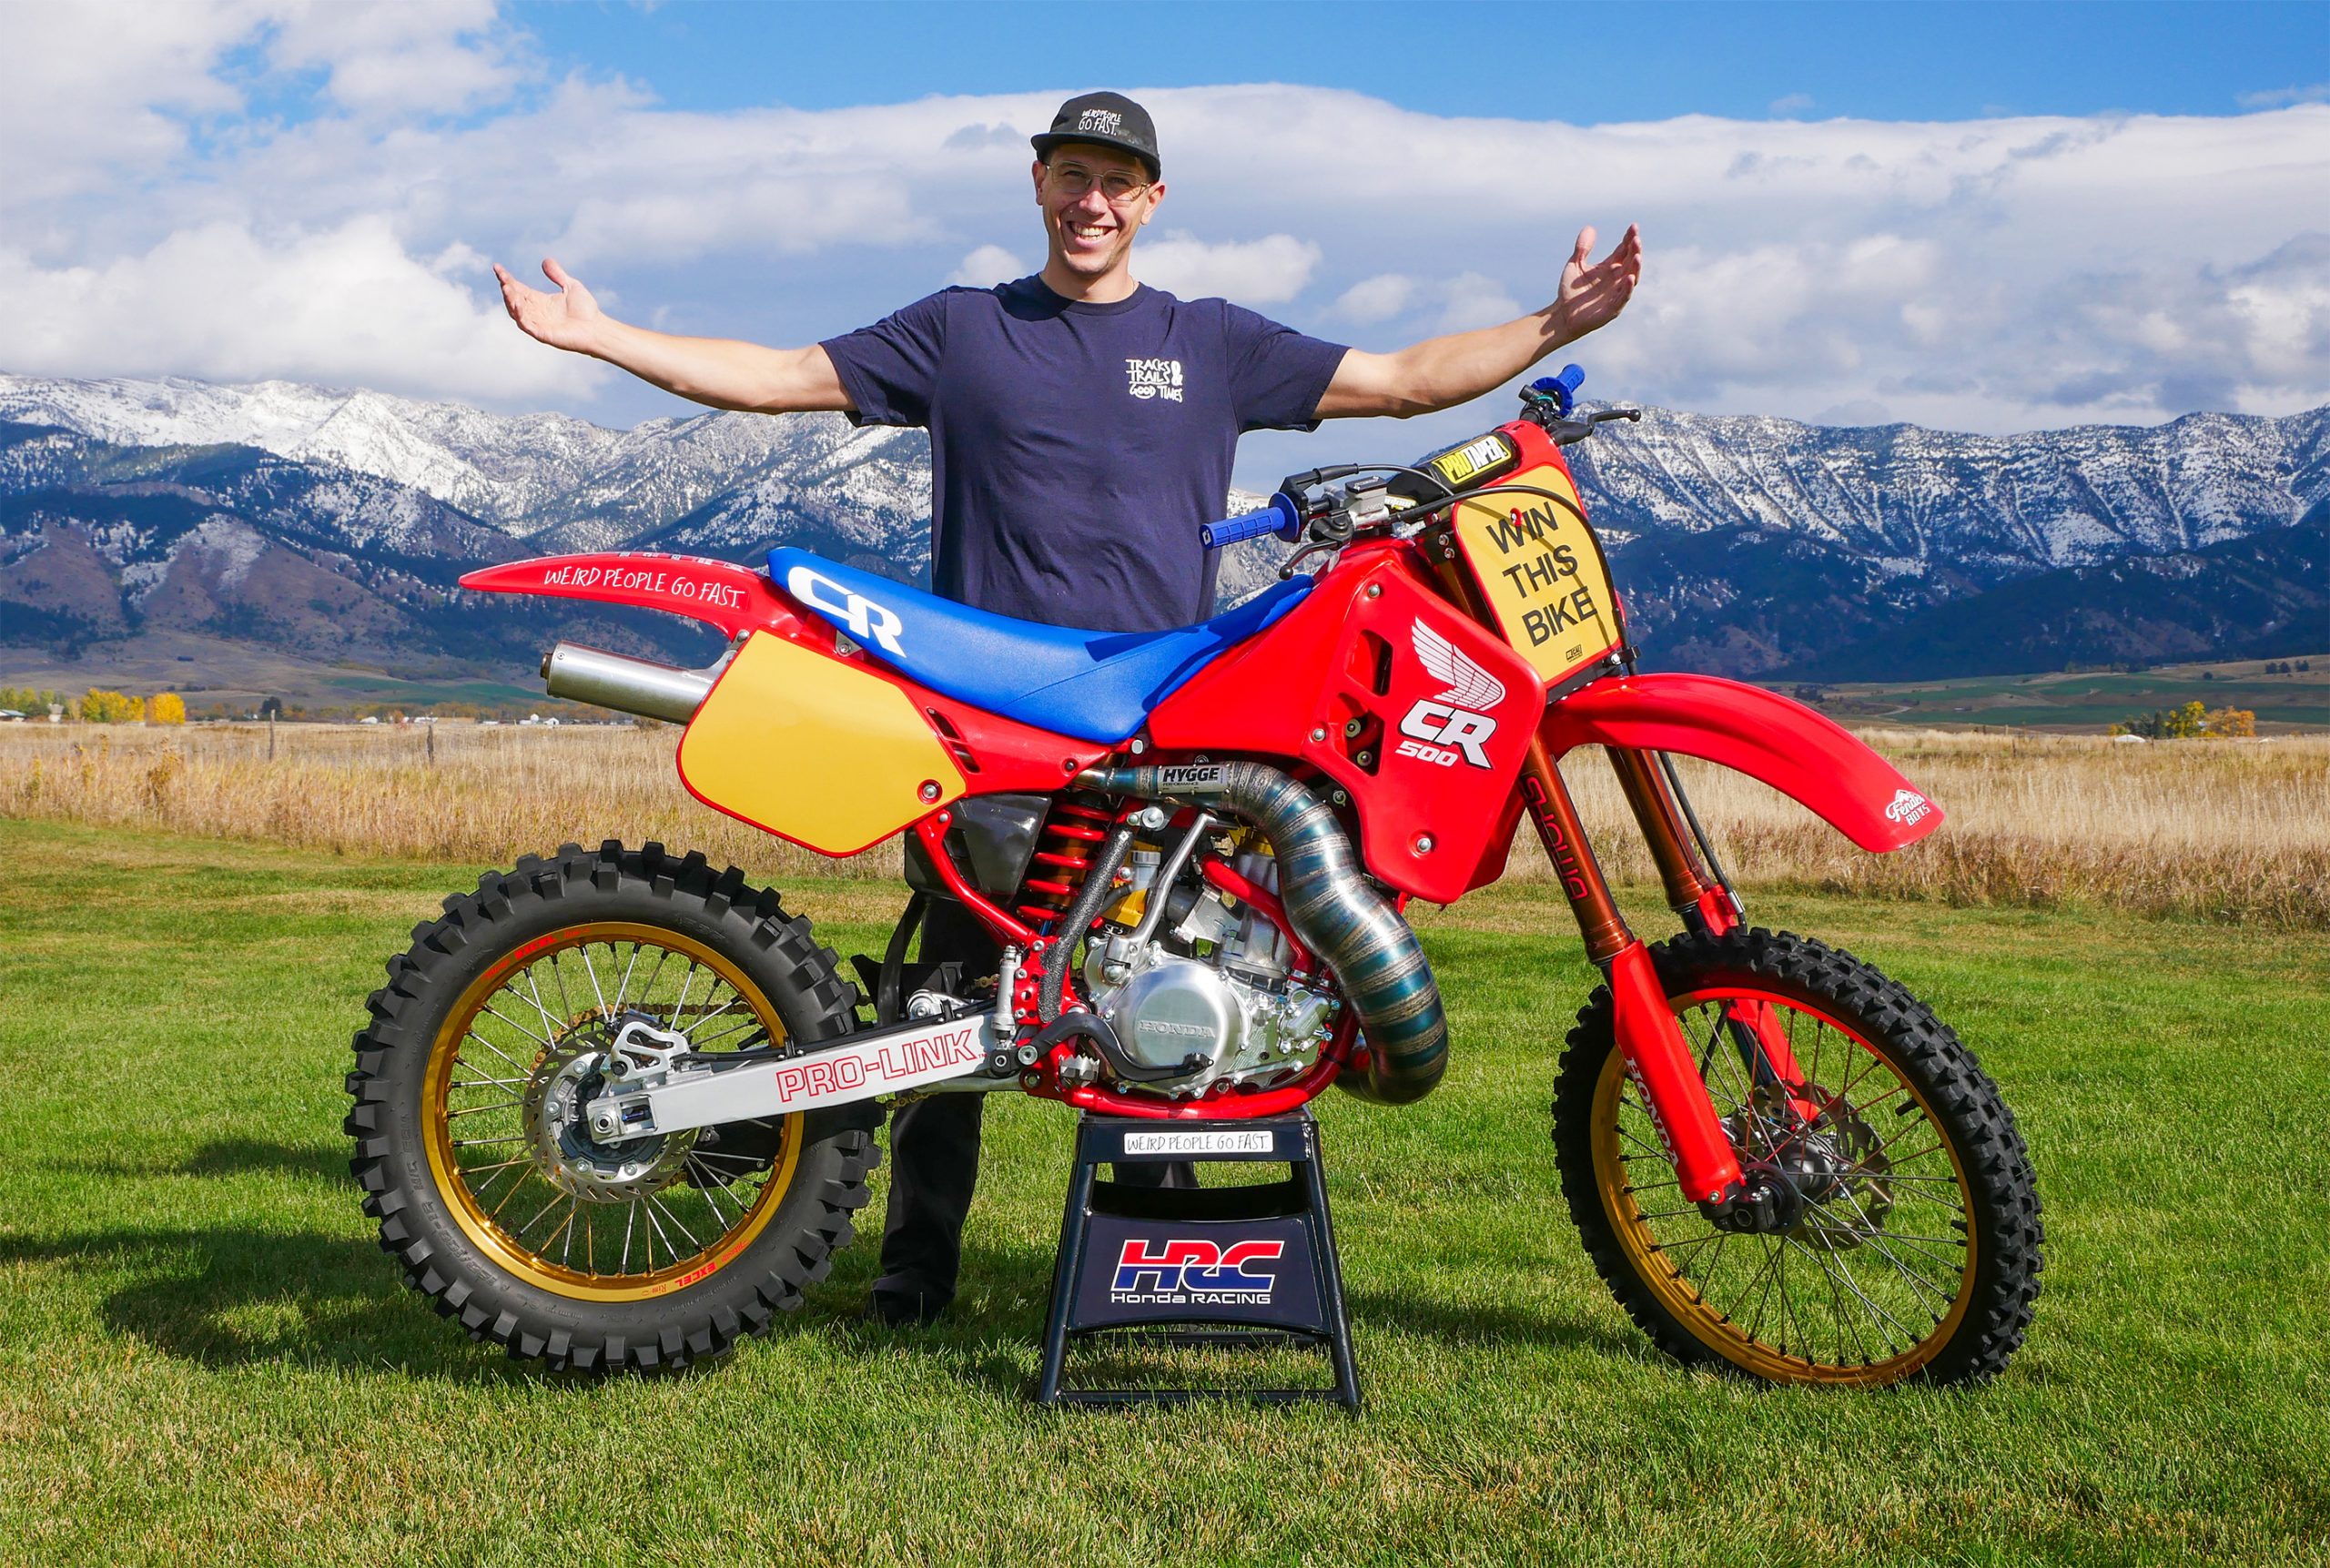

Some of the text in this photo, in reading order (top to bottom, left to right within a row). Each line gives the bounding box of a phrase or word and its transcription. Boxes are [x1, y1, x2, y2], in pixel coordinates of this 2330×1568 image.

[1078, 116, 1092, 130] GO
[1125, 359, 1171, 374] TRACKS
[1125, 369, 1170, 384] TRAILS
[1129, 383, 1183, 403] GOOD TIMES
[1485, 501, 1559, 554] WIN
[543, 565, 601, 587] WEIRD
[603, 567, 667, 592] PEOPLE
[670, 576, 695, 598] GO
[1502, 544, 1578, 599] THIS
[787, 566, 907, 658] CR
[1522, 585, 1597, 647] BIKE
[1399, 698, 1498, 770] CR
[1394, 740, 1459, 767] 500
[1162, 767, 1220, 783] HYGGE
[1904, 804, 1930, 826] BOYS
[1140, 1019, 1216, 1038] HONDA
[775, 1028, 977, 1103] PRO-LINK
[1625, 1057, 1679, 1168] HONDA
[1127, 1136, 1166, 1151] WEIRD
[1169, 1135, 1213, 1150] PEOPLE
[1217, 1137, 1234, 1149] GO
[674, 1261, 718, 1288] EXCEL
[1110, 1239, 1285, 1292] HRC
[1111, 1292, 1271, 1305] Honda RACING
